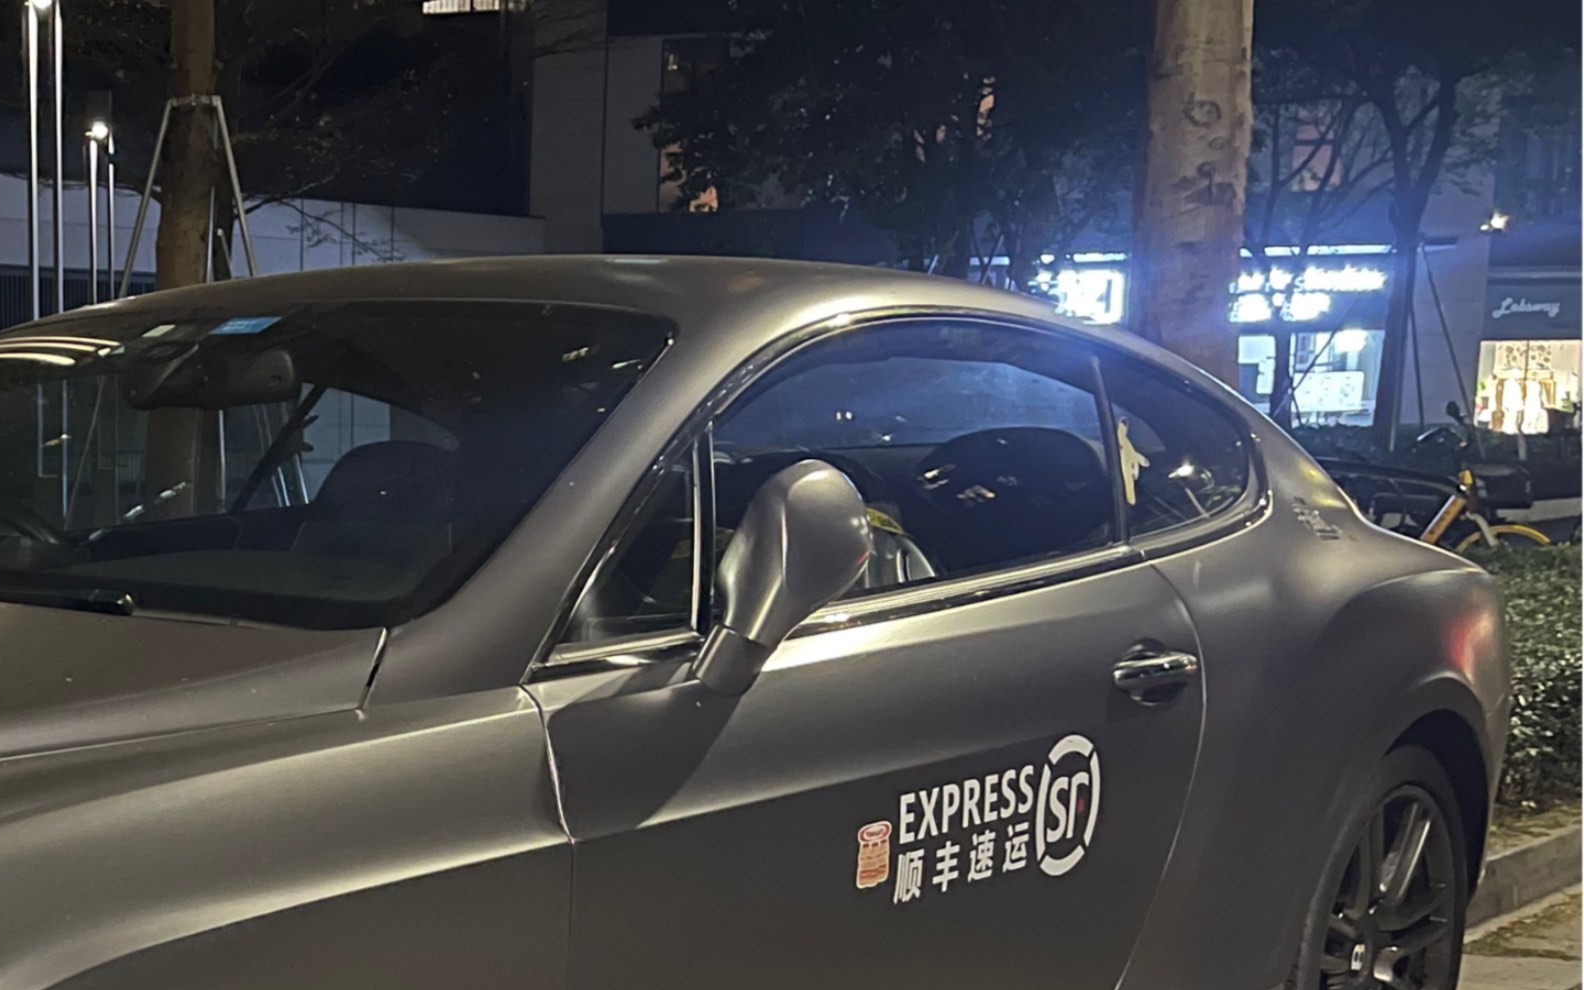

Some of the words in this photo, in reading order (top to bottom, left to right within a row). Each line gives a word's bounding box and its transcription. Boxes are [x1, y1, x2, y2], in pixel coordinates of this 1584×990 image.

[899, 765, 1034, 844] EXPRESS
[893, 822, 1029, 904] 顺丰速运
